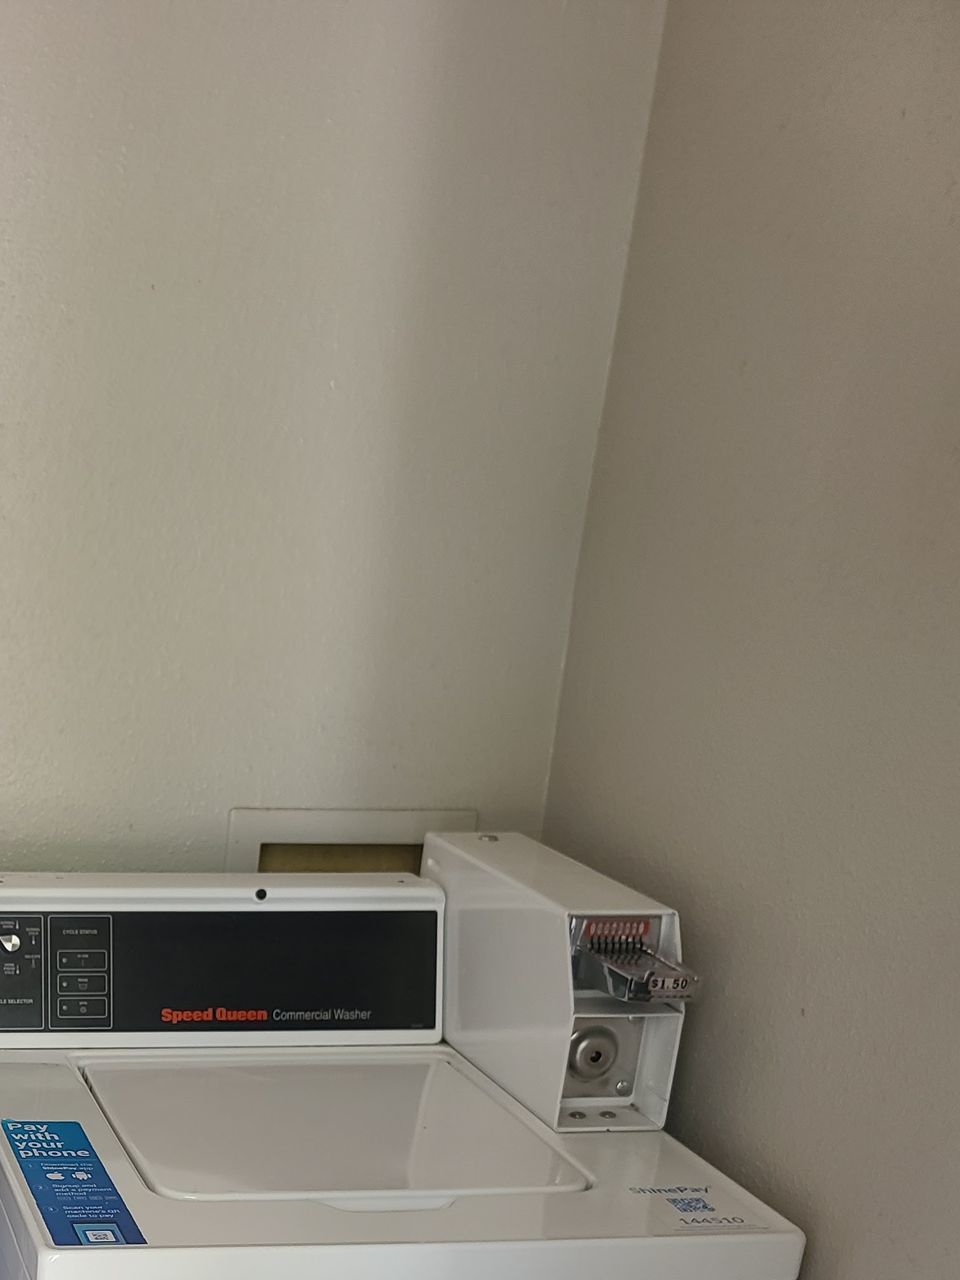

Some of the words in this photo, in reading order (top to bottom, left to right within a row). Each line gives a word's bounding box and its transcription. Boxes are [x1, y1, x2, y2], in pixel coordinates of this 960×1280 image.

[652, 980, 688, 989] $1.50
[161, 1008, 212, 1023] Speed
[216, 1008, 267, 1021] Queen
[273, 1009, 331, 1021] Commercial
[334, 1009, 371, 1020] Washer
[7, 1123, 48, 1132] Pay
[11, 1132, 59, 1140] with
[16, 1141, 64, 1150] your
[19, 1149, 90, 1158] phone
[629, 1186, 709, 1194] ShinePay
